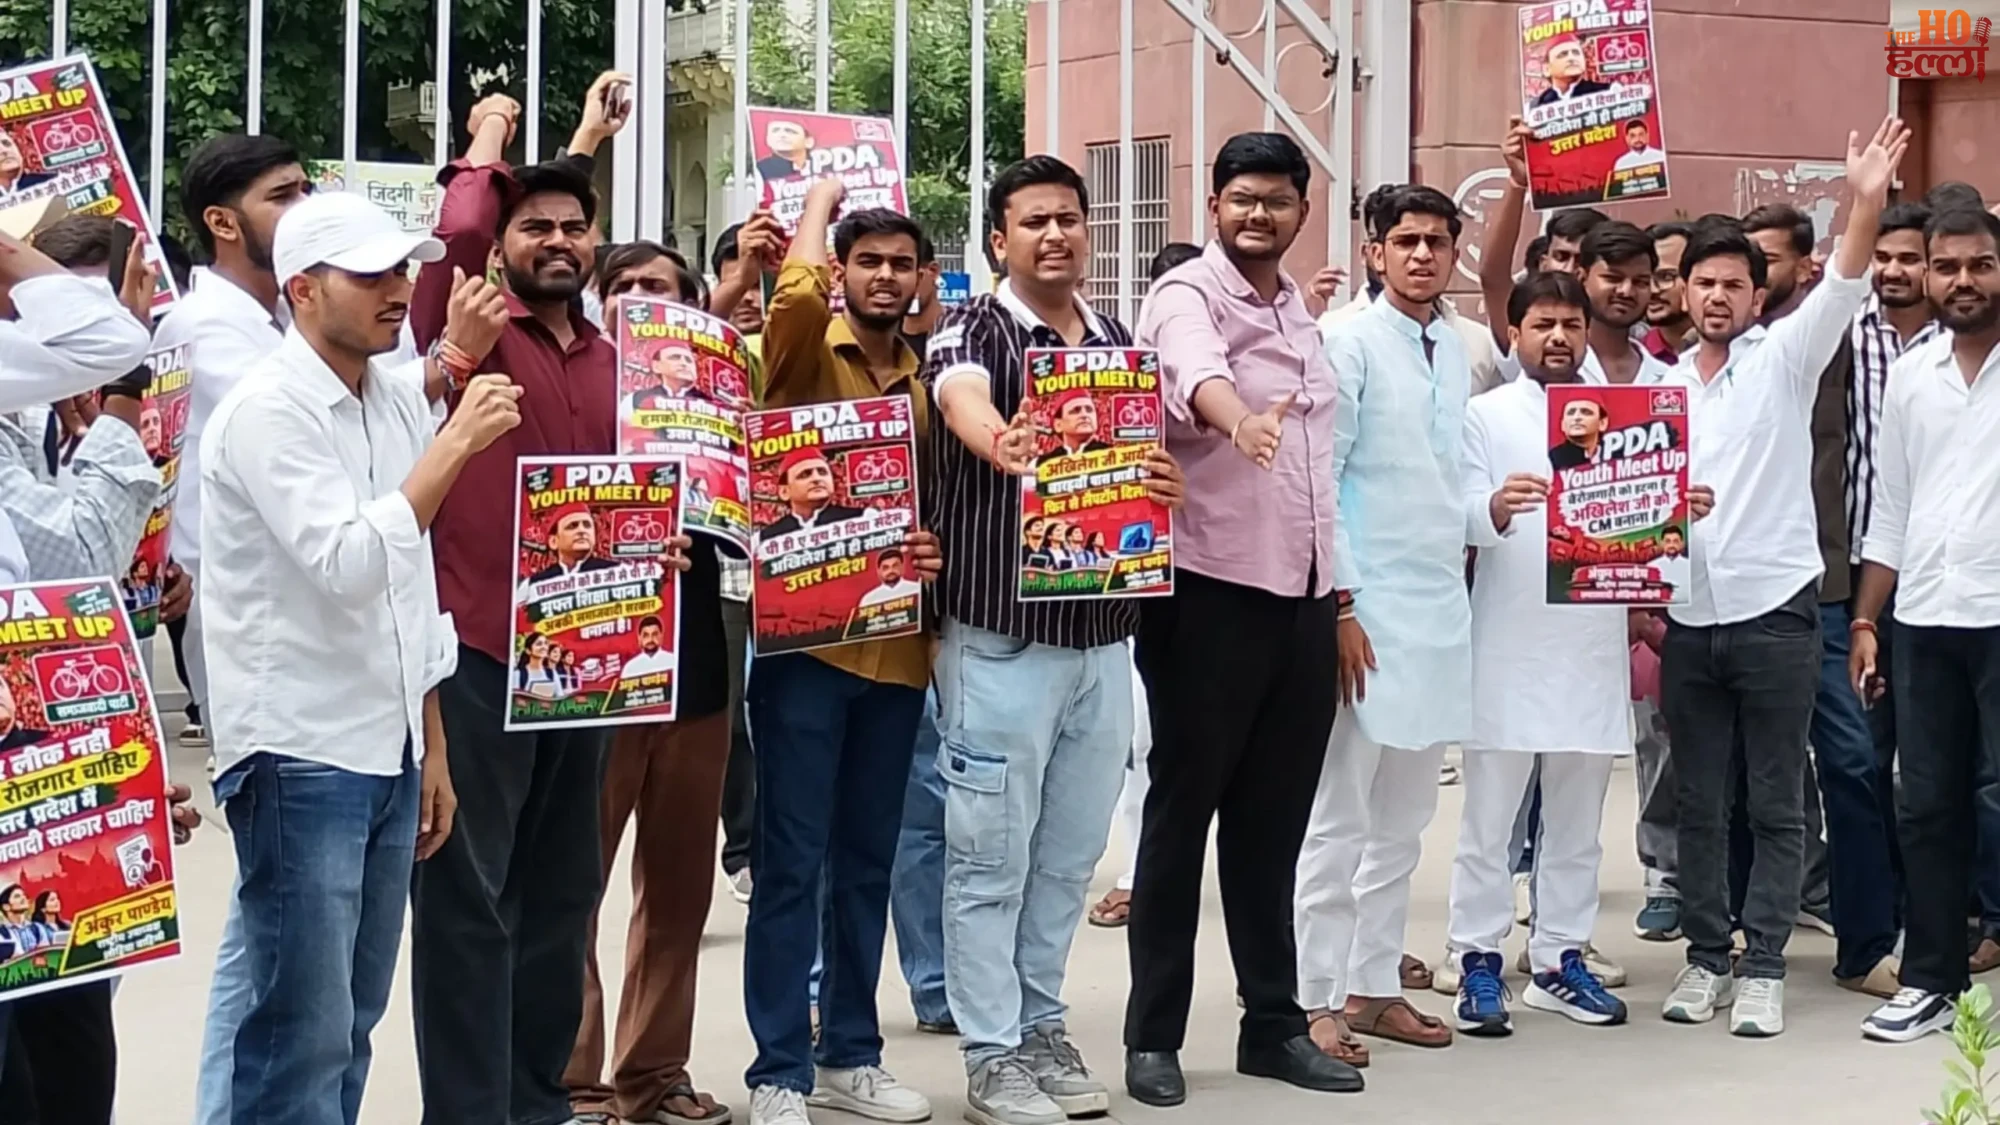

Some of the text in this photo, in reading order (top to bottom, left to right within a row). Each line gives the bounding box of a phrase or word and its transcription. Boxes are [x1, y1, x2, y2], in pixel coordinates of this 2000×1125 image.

[1553, 0, 1608, 21] PDA
[1523, 10, 1646, 43] YOUTH MEET UP
[1, 94, 52, 119] MEET
[56, 88, 87, 107] UP
[1549, 124, 1618, 156] उत्तर प्रदेश
[810, 144, 878, 174] PDA
[873, 167, 898, 188] Up
[665, 307, 725, 340] PDA
[629, 322, 689, 341] YOUTH
[692, 331, 731, 357] MEET
[1064, 351, 1129, 373] PDA
[1034, 370, 1157, 395] YOUTH MEET UP
[791, 402, 860, 432] PDA
[750, 420, 908, 459] YOUTH MEET UP
[1601, 421, 1669, 461] PDA
[566, 463, 635, 487] PDA
[1046, 453, 1098, 477] अखिलेश
[1101, 450, 1116, 466] जी
[1559, 449, 1687, 491] Youth Meet Up
[529, 485, 673, 510] YOUTH MEET UP
[1571, 500, 1630, 522] अखिलेश
[1634, 495, 1650, 510] जी
[1588, 518, 1612, 534] CM
[770, 549, 826, 576] अखिलेश
[828, 541, 846, 559] जी
[783, 556, 868, 593] उत्तर प्रदेश
[612, 583, 642, 600] पाना
[0, 616, 115, 645] MEET UP
[10, 743, 65, 777] लीक
[2, 767, 77, 803] रोजगार
[82, 749, 138, 780] चाहिए
[29, 796, 78, 826] प्रदेश
[80, 784, 98, 808] में
[45, 815, 103, 847] सरकार
[105, 799, 155, 829] चाहिए
[84, 895, 172, 936] अंकुर पाण्डेय
